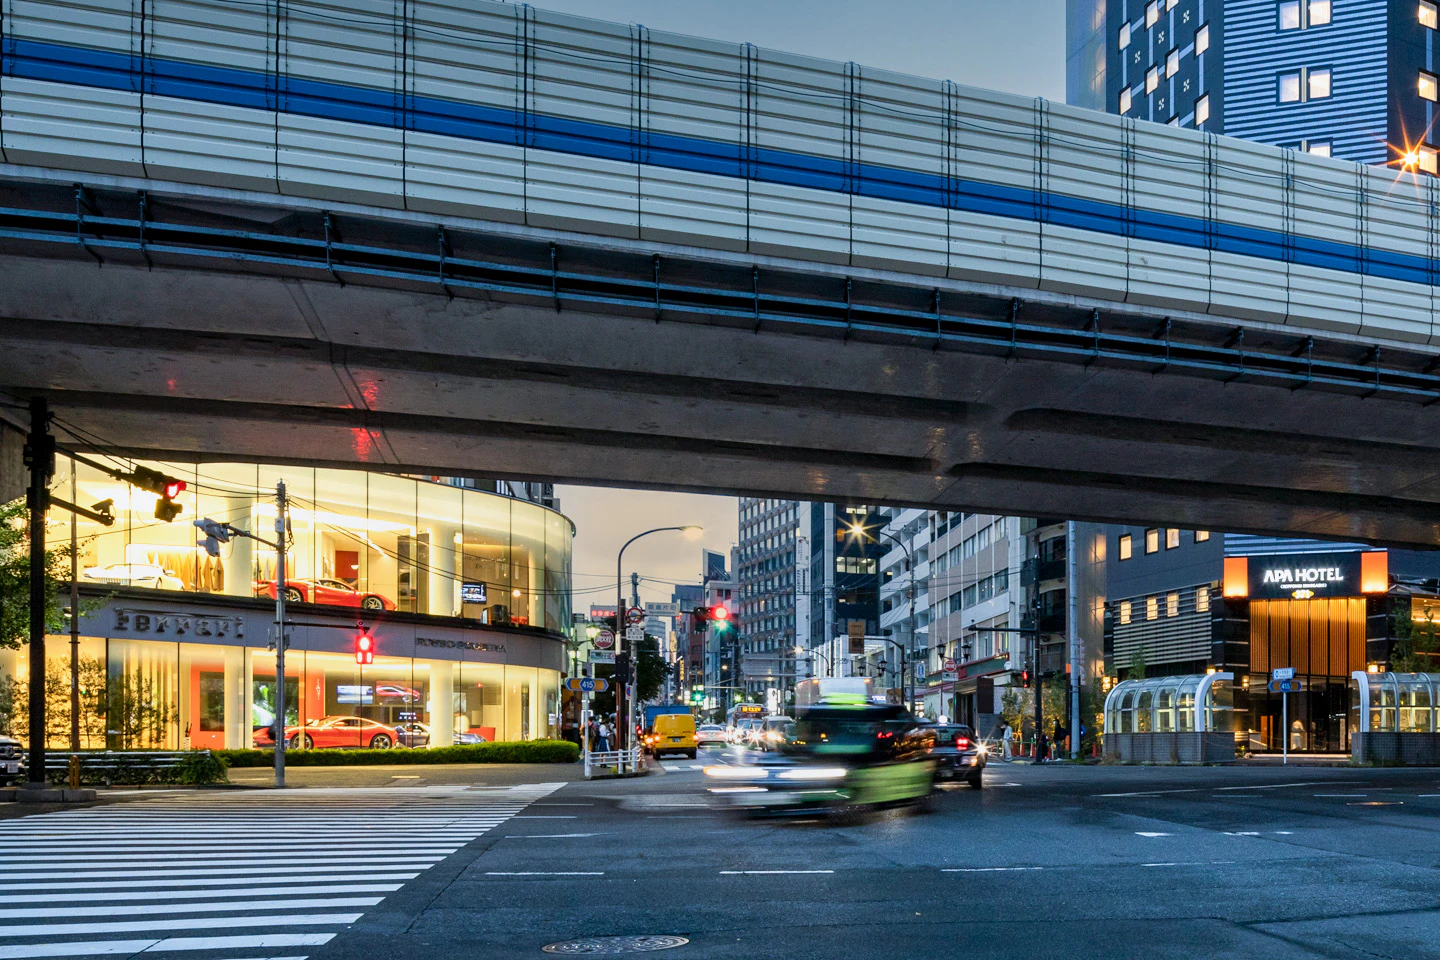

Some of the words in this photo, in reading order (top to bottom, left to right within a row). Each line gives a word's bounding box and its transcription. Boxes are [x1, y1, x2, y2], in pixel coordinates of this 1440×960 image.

[1263, 569, 1294, 583] APA
[1295, 567, 1344, 581] HOTEL
[112, 607, 244, 638] Ferrari
[581, 680, 594, 689] 415
[1280, 682, 1291, 690] 415
